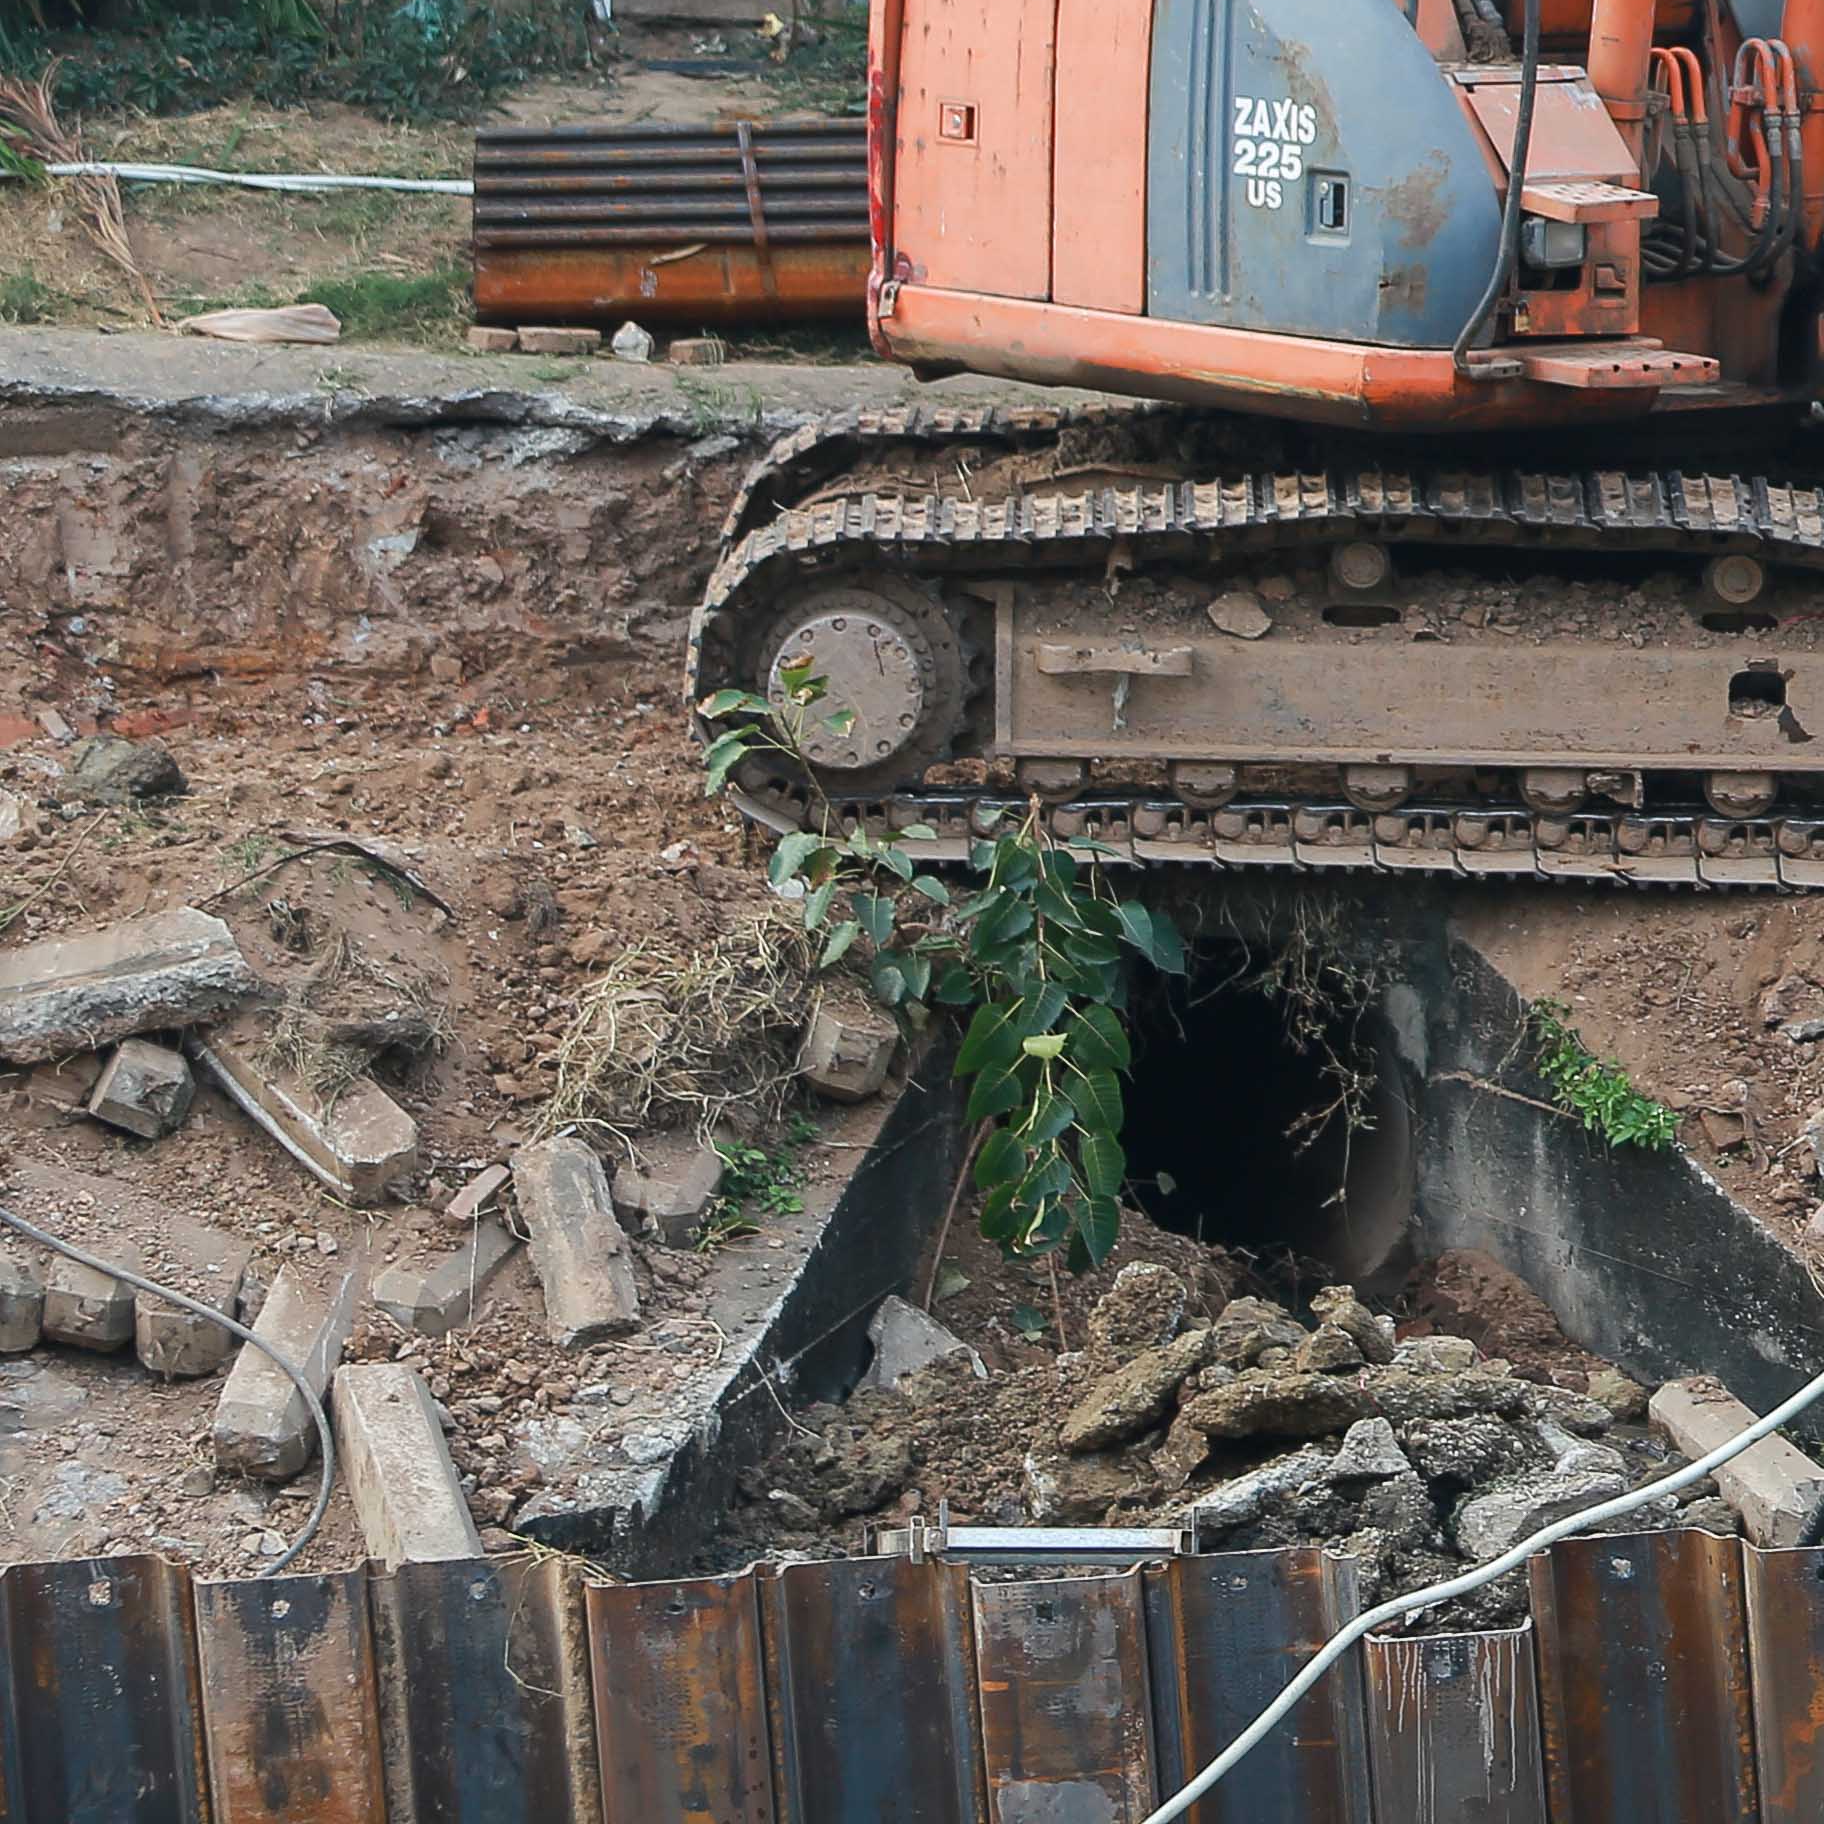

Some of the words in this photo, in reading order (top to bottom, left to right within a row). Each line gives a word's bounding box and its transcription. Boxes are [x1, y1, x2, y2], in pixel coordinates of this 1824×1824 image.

[1233, 96, 1317, 144] ZAXIS
[1232, 138, 1303, 180] 225
[1246, 177, 1282, 209] US
